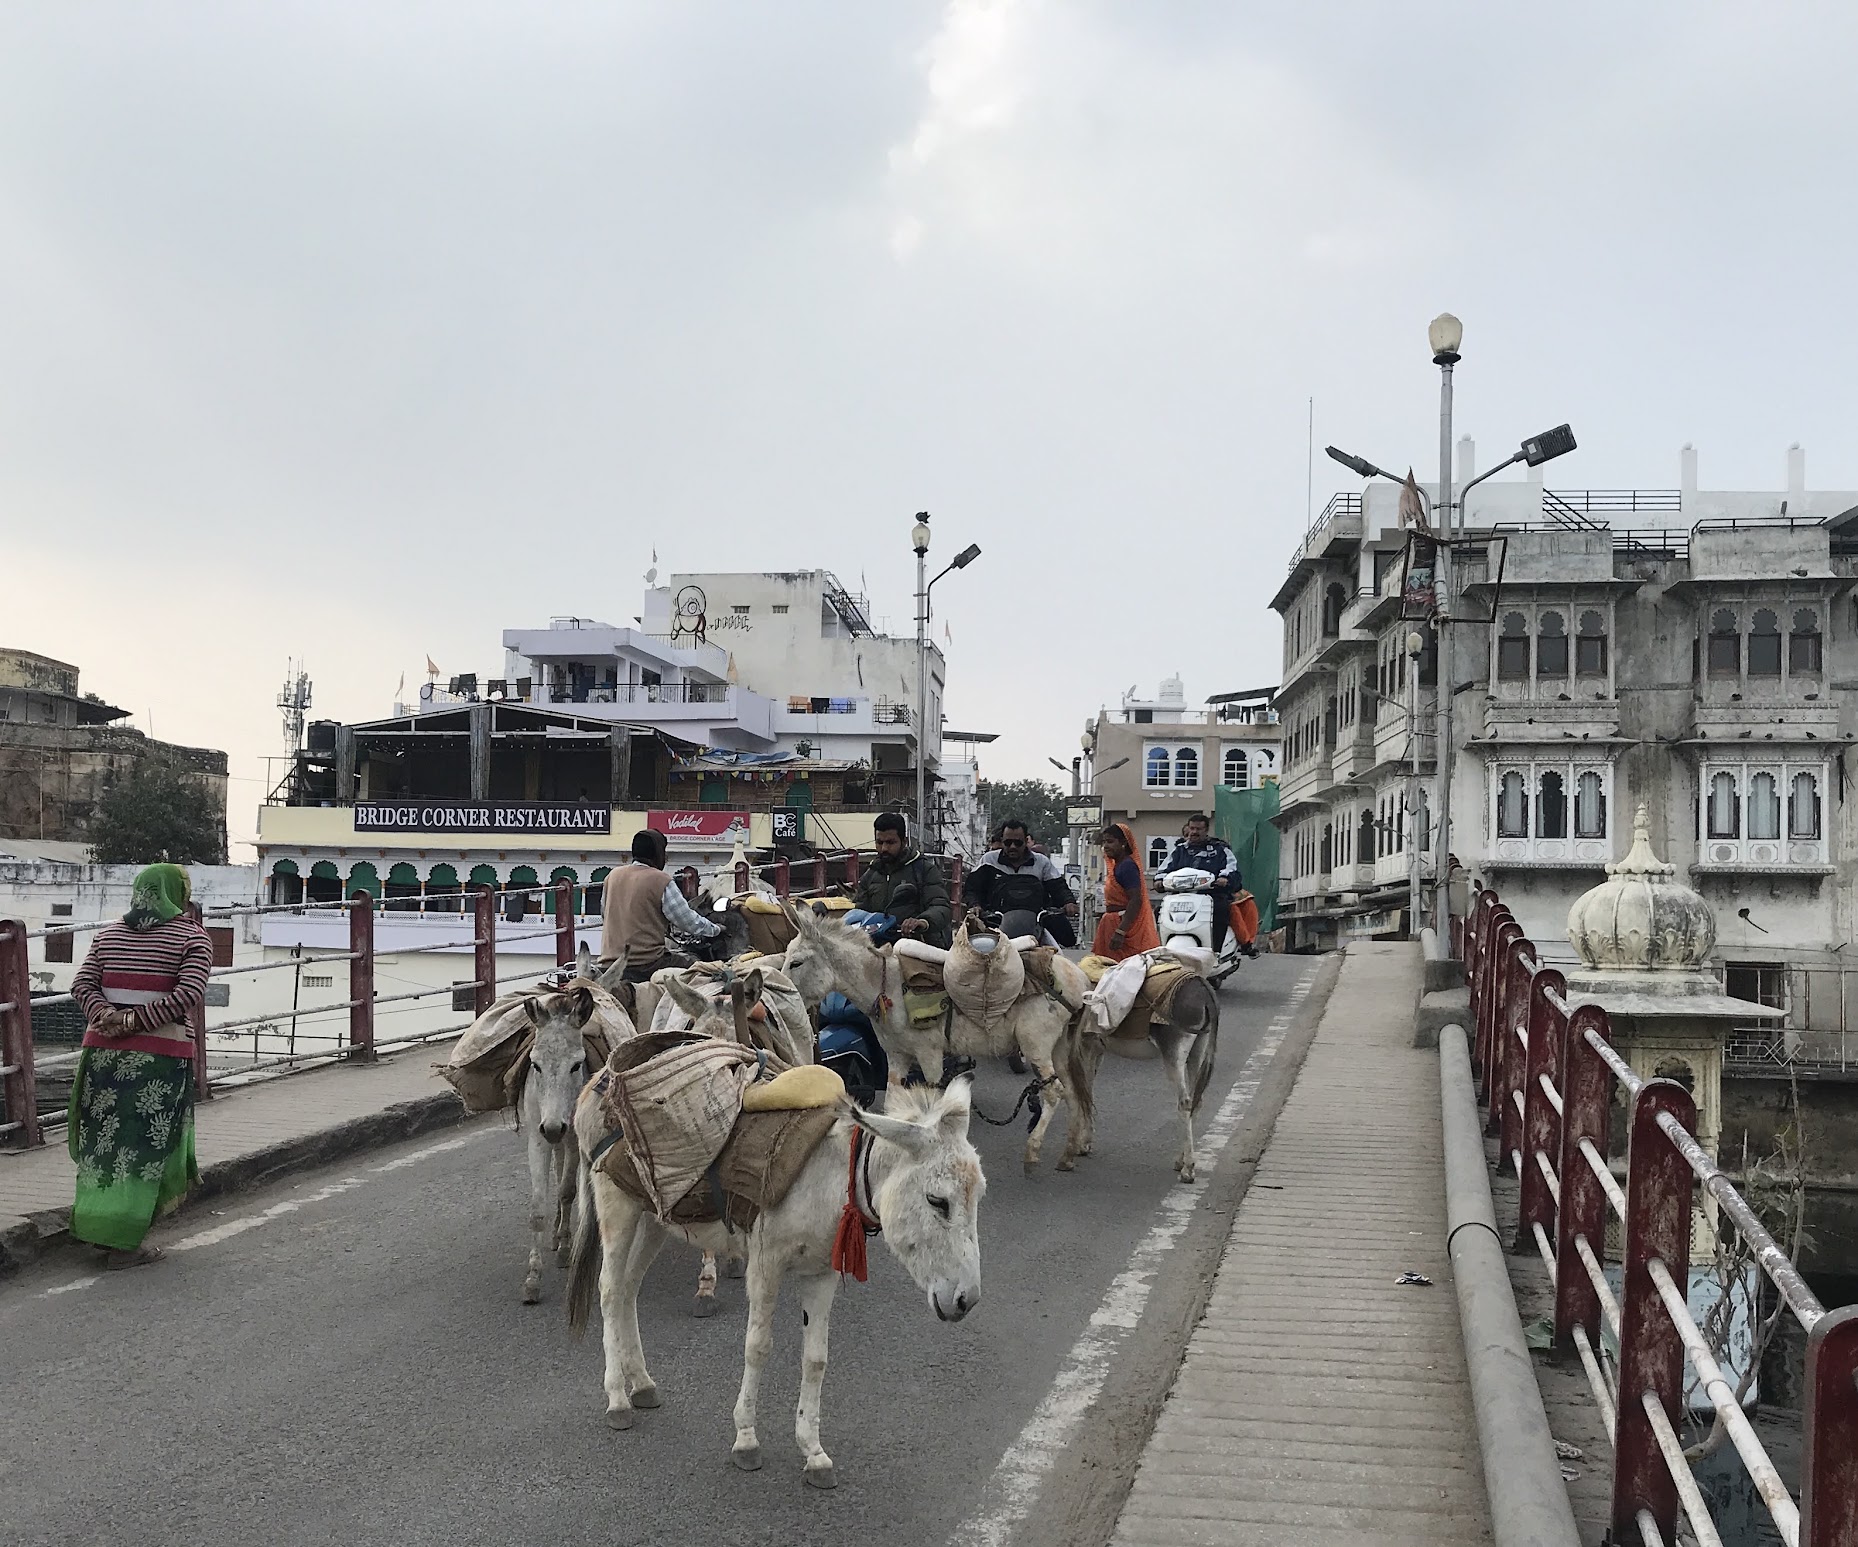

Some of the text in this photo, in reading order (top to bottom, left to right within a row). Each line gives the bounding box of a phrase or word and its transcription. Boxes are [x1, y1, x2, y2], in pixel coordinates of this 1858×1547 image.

[356, 807, 607, 828] BRIDGE CORNER RESTAURANT
[668, 813, 703, 833] Vadilal
[774, 813, 797, 829] BC
[775, 828, 796, 837] Café
